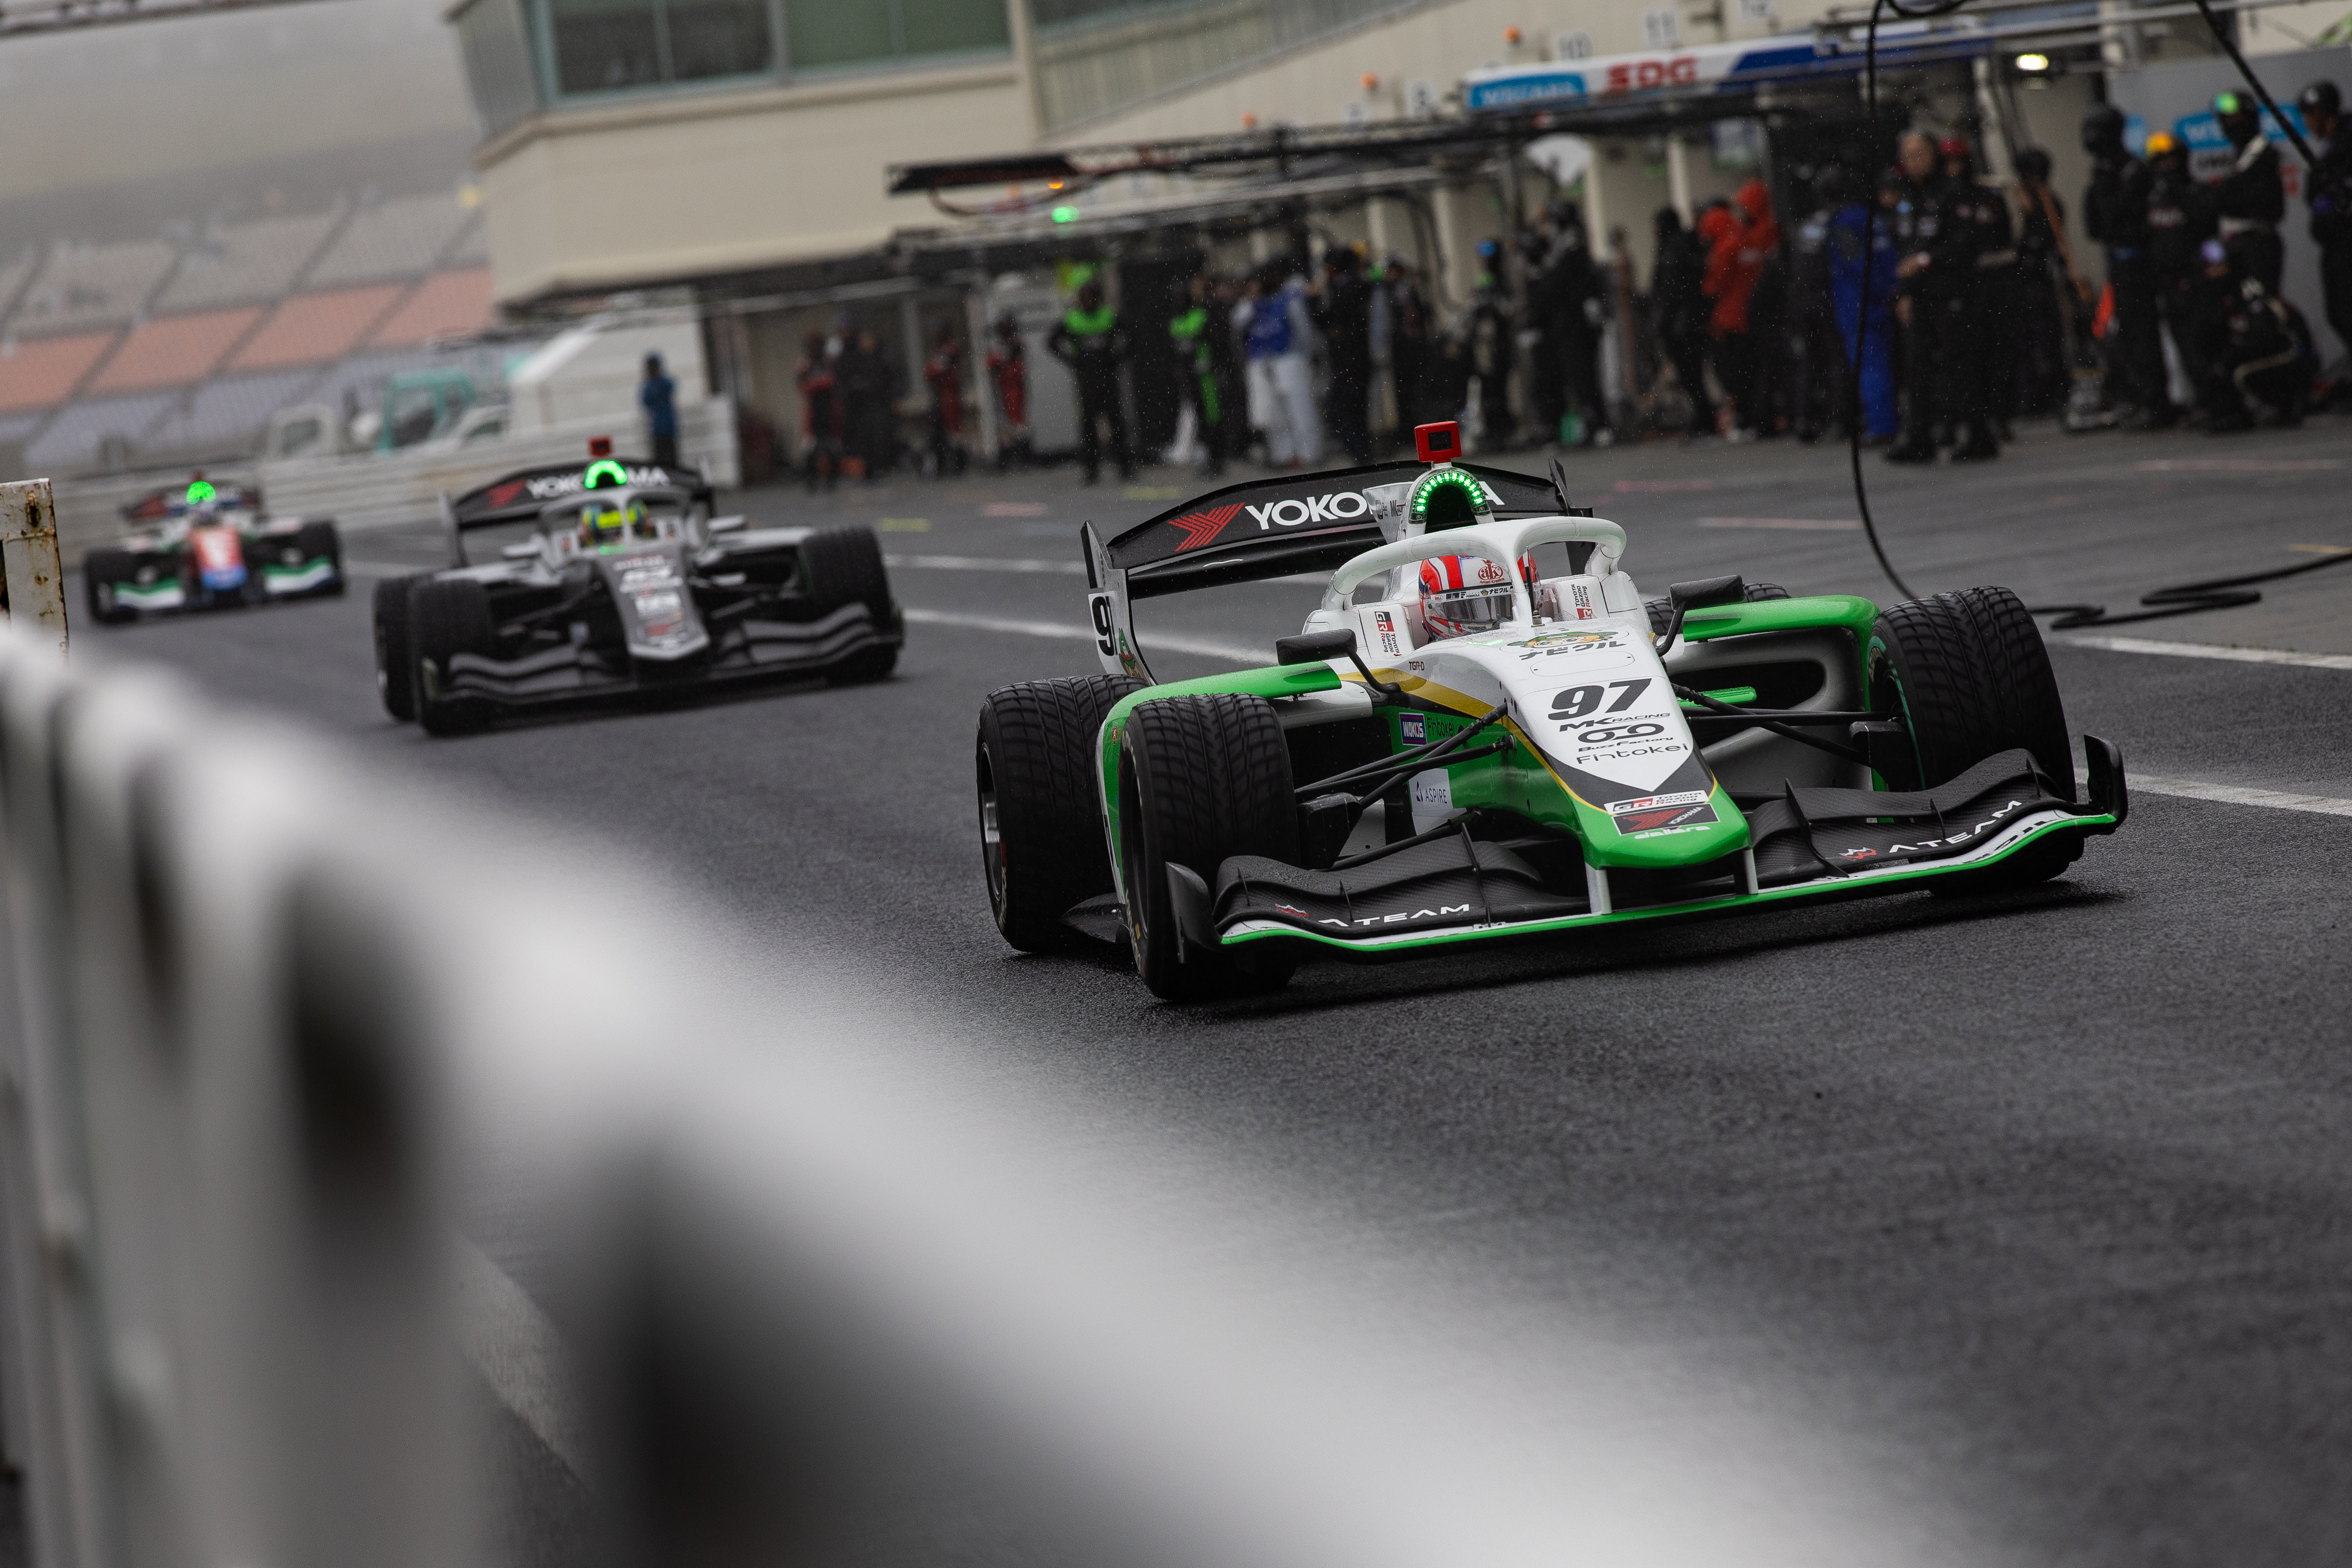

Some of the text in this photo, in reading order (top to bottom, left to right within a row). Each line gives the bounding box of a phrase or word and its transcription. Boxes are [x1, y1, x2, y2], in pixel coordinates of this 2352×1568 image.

[1608, 57, 1697, 93] SDG
[1571, 584, 1580, 607] TOYOTA
[1577, 586, 1586, 607] GAZOO
[1582, 586, 1591, 607] Racing
[1375, 612, 1388, 631] GR
[1386, 633, 1394, 653] GAZOO
[1391, 633, 1400, 653] TOYOTA
[1519, 641, 1627, 661] ナビクル
[1409, 661, 1425, 671] TGR-D
[1548, 678, 1652, 720] 97
[1427, 717, 1455, 737] Fintokei
[1559, 713, 1671, 732] MK RACING
[1616, 736, 1674, 746] Factory
[1576, 743, 1688, 764] Fintokei
[1425, 788, 1447, 804] ASPIRE
[1614, 799, 1653, 812] GR
[1668, 806, 1704, 824] YOKOHAMA
